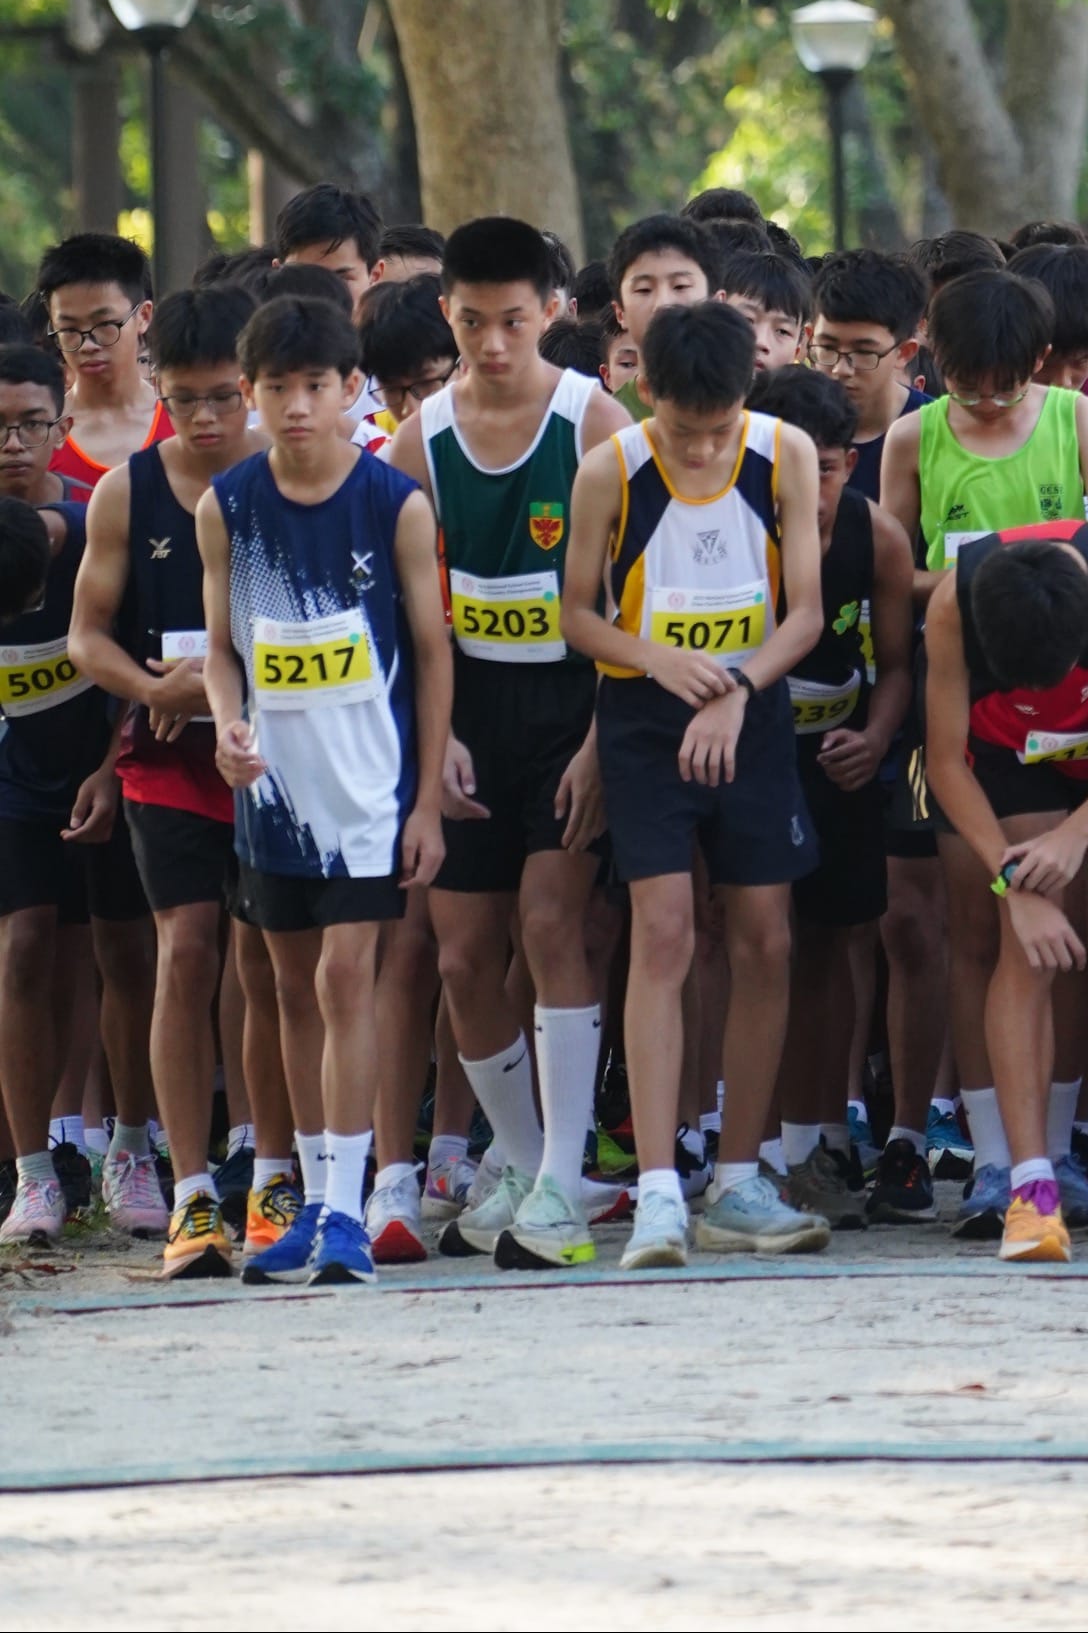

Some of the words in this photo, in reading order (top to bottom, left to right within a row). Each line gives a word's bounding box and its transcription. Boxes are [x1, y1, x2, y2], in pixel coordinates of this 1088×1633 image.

[463, 604, 550, 638] 5203
[664, 614, 752, 651] 5071
[7, 658, 78, 698] 500
[264, 645, 356, 684] 5217
